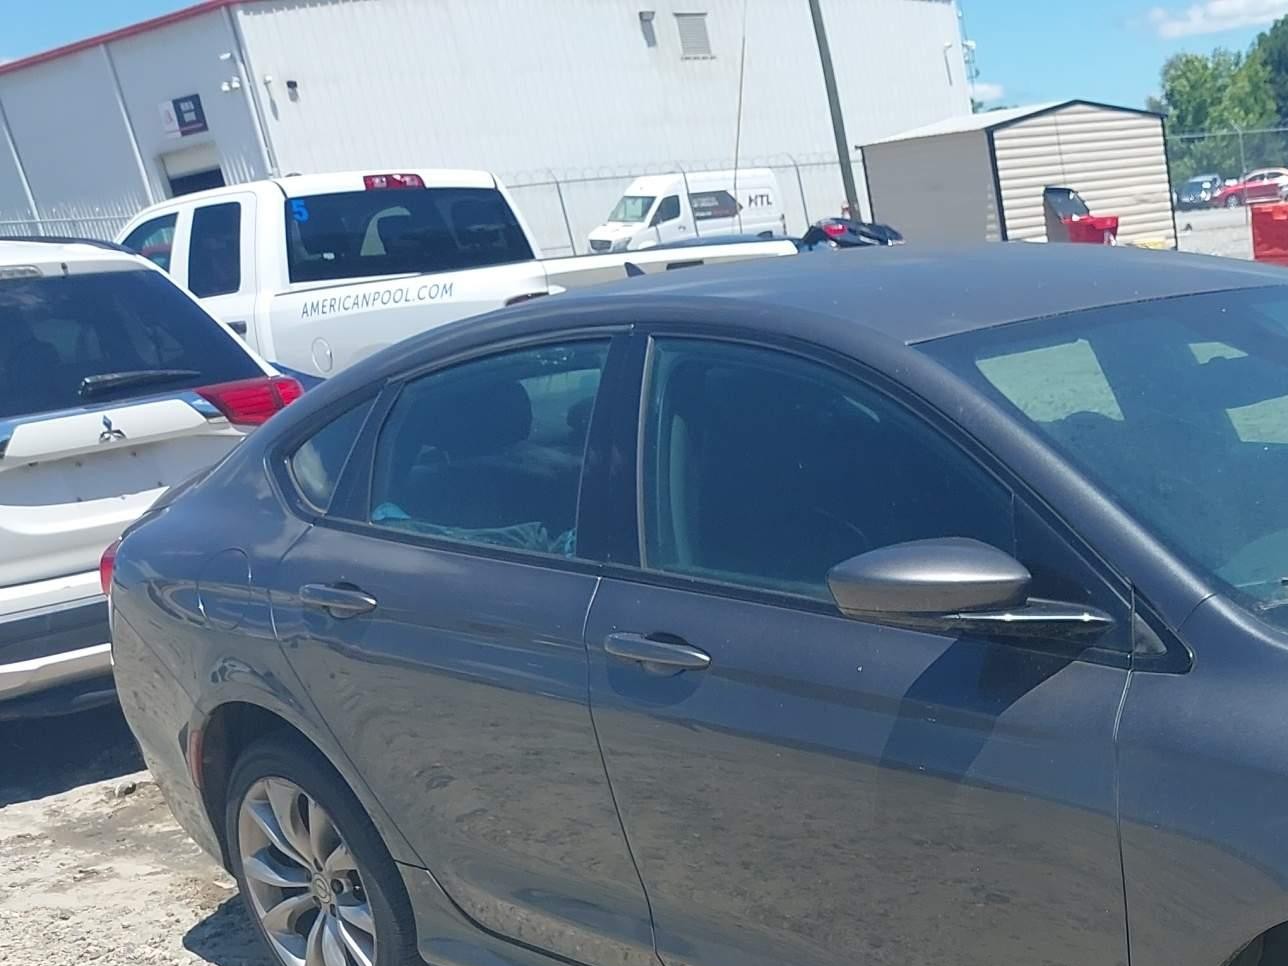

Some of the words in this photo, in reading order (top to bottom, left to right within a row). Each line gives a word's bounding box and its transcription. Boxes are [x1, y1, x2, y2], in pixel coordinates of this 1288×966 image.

[291, 199, 309, 223] 5
[748, 194, 772, 208] HTL
[301, 282, 454, 318] AMERICANPOOL.COM
